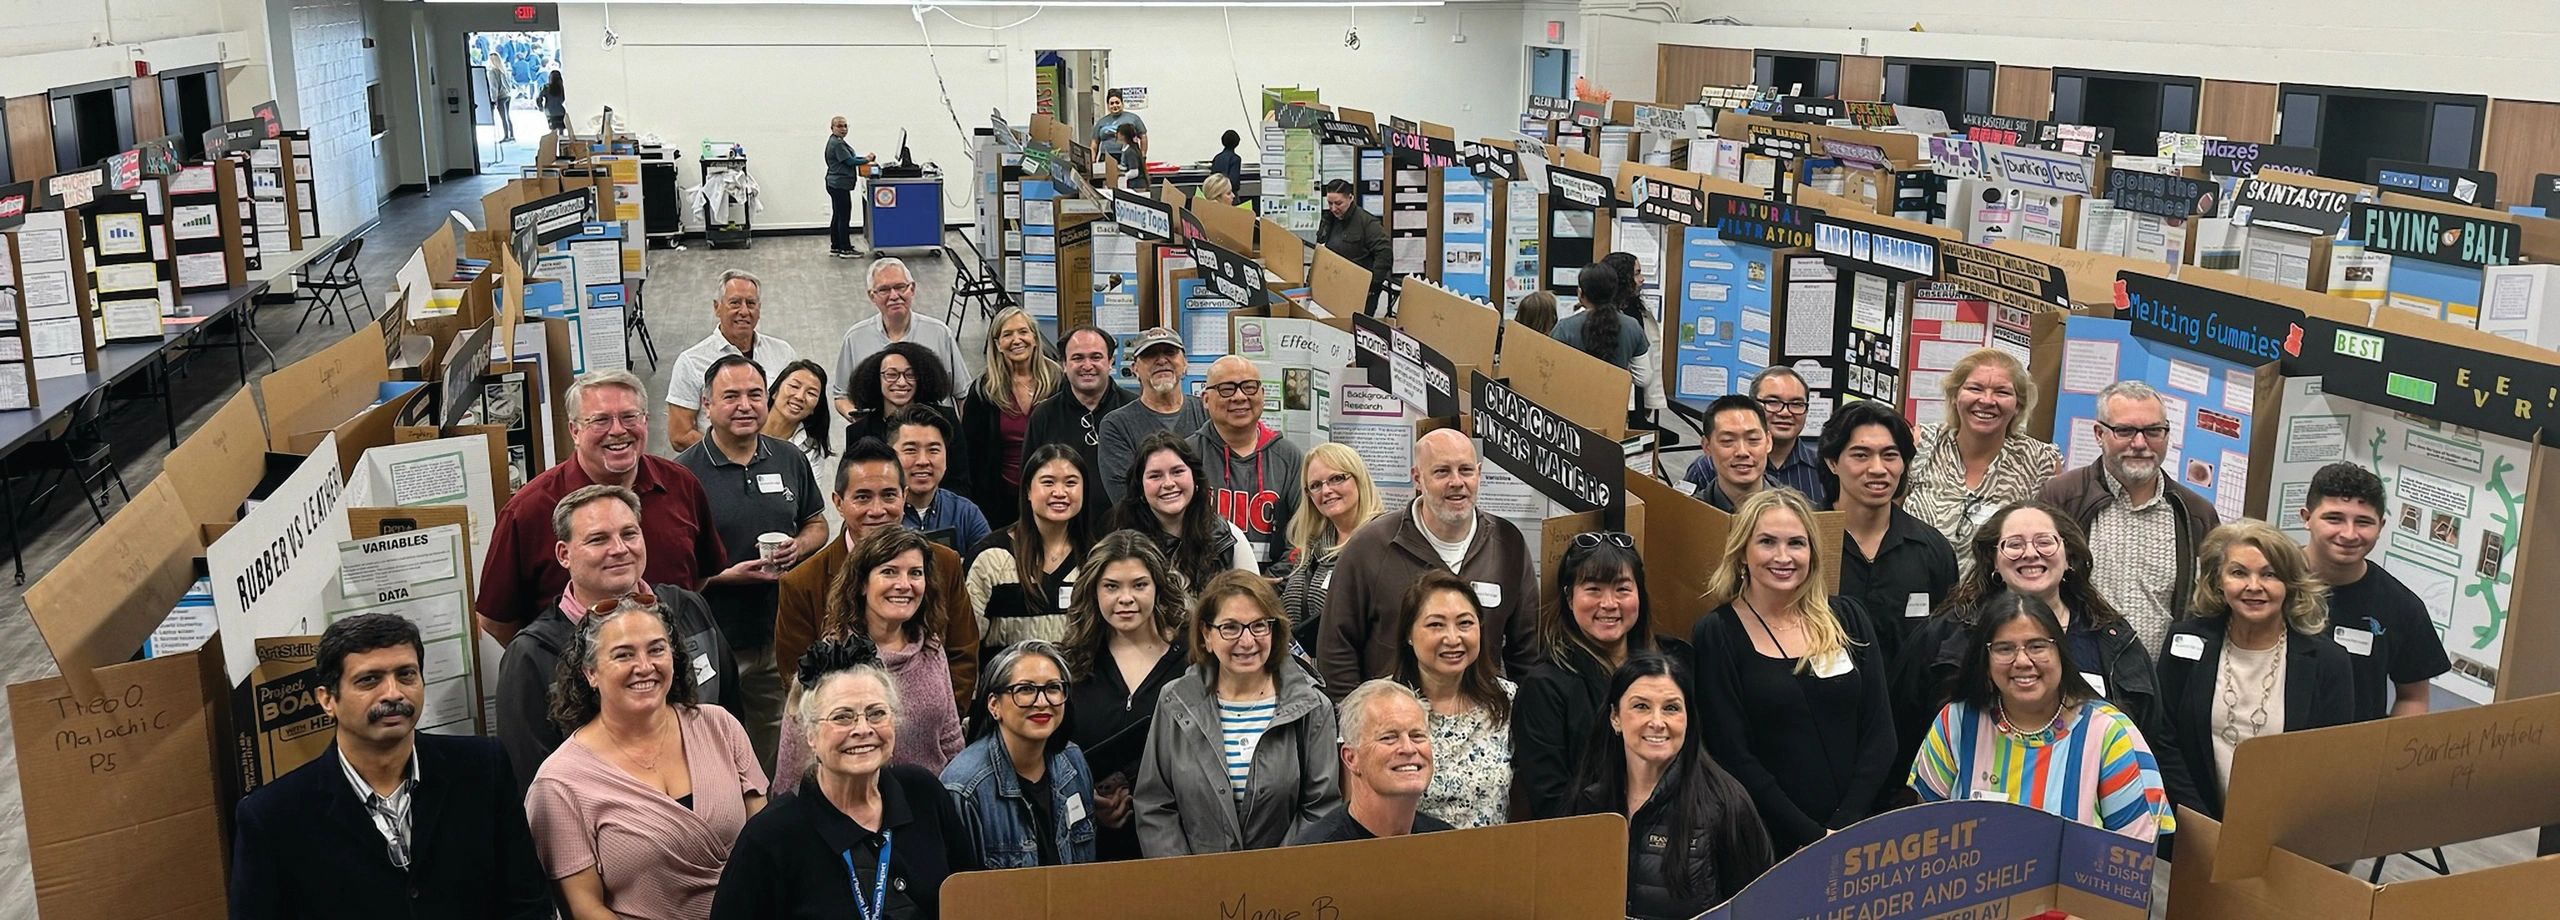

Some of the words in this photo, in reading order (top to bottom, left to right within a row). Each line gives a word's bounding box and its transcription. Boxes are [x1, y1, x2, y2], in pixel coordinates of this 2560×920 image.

[1982, 115, 2014, 131] BASKETBALL
[1392, 132, 1430, 152] COOKIE
[50, 170, 102, 192] FLAVORFUL
[2006, 158, 2050, 184] Dunking
[2052, 165, 2085, 185] Oreos
[2111, 170, 2166, 196] Going
[2167, 174, 2198, 198] the
[2247, 179, 2347, 213] SKINTASTIC
[1116, 201, 1147, 228] Spinning
[1148, 209, 1169, 233] Tops
[1727, 199, 1801, 226] NATURAL
[1717, 217, 1812, 248] FILTRATION
[2365, 208, 2440, 255] FLYING
[2461, 222, 2510, 265] BALL
[1815, 222, 1849, 256] LAWS
[1853, 230, 1869, 260] OF
[1872, 234, 1933, 273] DENSITY
[1942, 244, 1974, 260] WHICH
[1974, 248, 2001, 265] FRUIT
[2003, 255, 2026, 273] WILL
[2026, 261, 2046, 279] ROT
[1959, 262, 1997, 282] FASTER
[2003, 271, 2036, 292] UNDER
[2130, 292, 2200, 344] Melting
[2205, 312, 2281, 361] Gummies
[1280, 334, 1320, 354] Effects
[2337, 333, 2382, 360] BEST
[1344, 400, 1383, 411] Research
[1485, 382, 1582, 457] CHARCOAL
[1473, 407, 1531, 465] FILTERS
[1535, 444, 1611, 507] WATER?
[362, 534, 429, 554] VARIABLES
[236, 536, 290, 614] RUBBER
[286, 514, 305, 560] VS
[378, 587, 409, 603] DATA
[256, 643, 321, 662] ArtSkills
[261, 679, 306, 703] Project
[56, 718, 147, 751] Malachi
[285, 722, 306, 736] WITH
[2396, 730, 2473, 771] Scarlett
[2479, 716, 2545, 761] Mayfield
[89, 752, 117, 774] P5
[1843, 818, 1979, 877] STAGE-IT
[1843, 863, 1916, 898] DISPLAY
[1920, 849, 1982, 879] BOARD
[2074, 871, 2111, 892] WITH
[1828, 890, 1915, 920] HEADER
[1921, 877, 1968, 909] AND
[1975, 858, 2038, 895] SHELF
